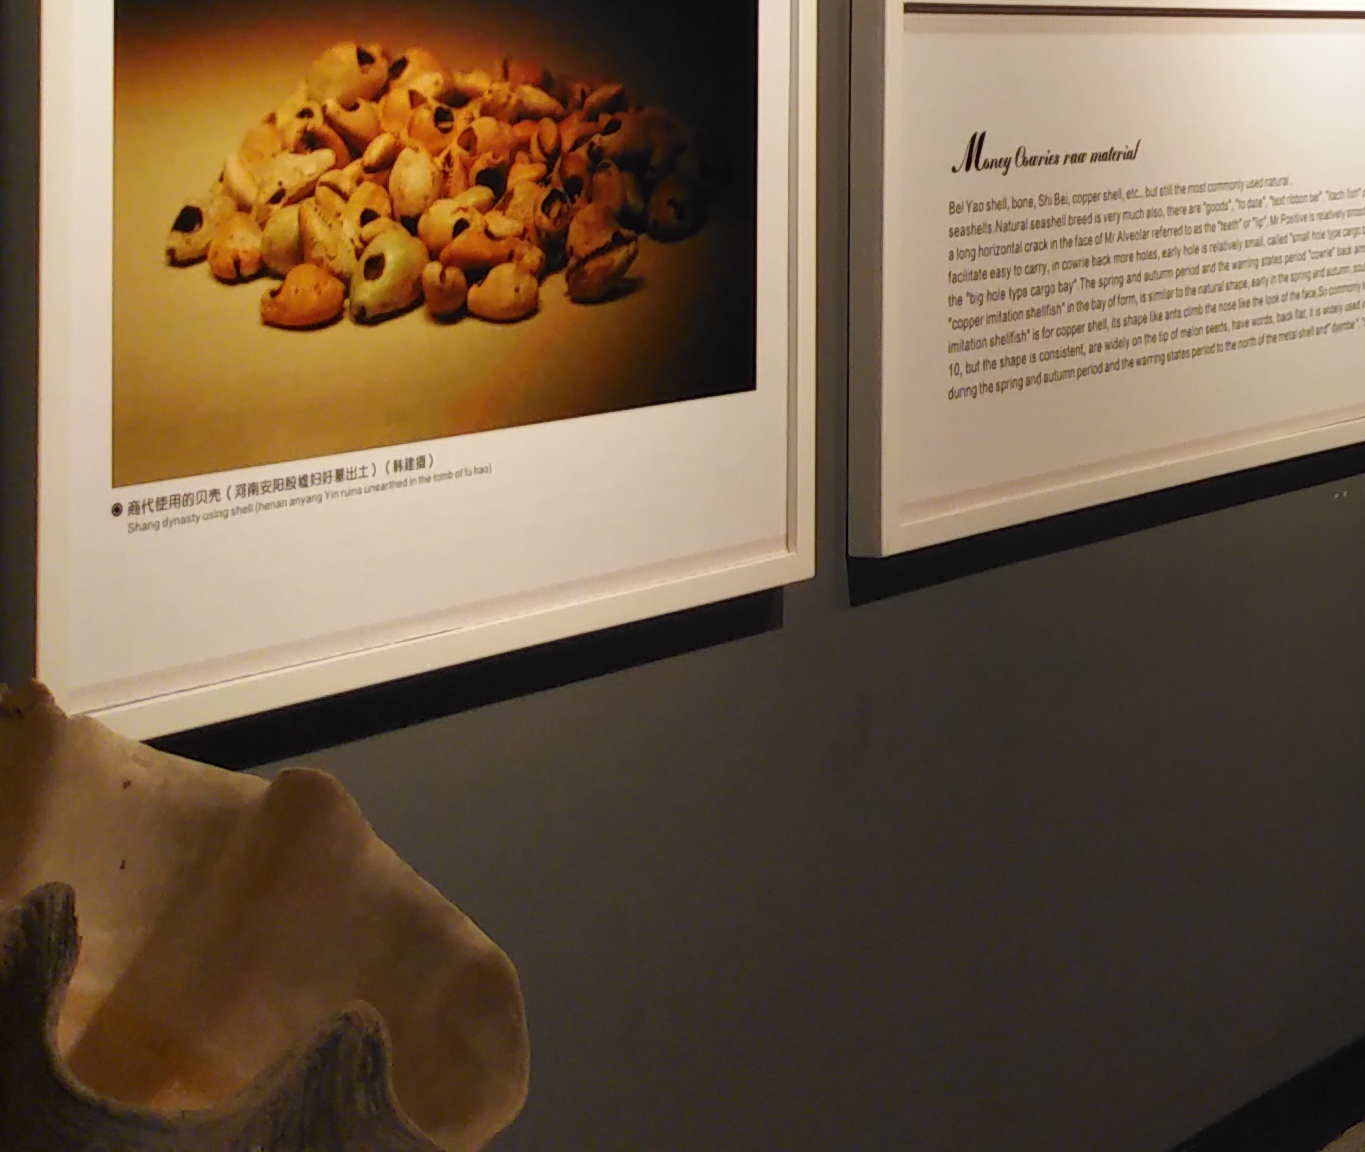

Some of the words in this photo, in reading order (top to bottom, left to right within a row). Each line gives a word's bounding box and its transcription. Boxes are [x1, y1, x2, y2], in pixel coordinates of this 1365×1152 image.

[952, 130, 1012, 176] Money
[1015, 146, 1059, 168] Cowries
[1062, 154, 1087, 166] raw
[1089, 139, 1142, 163] material
